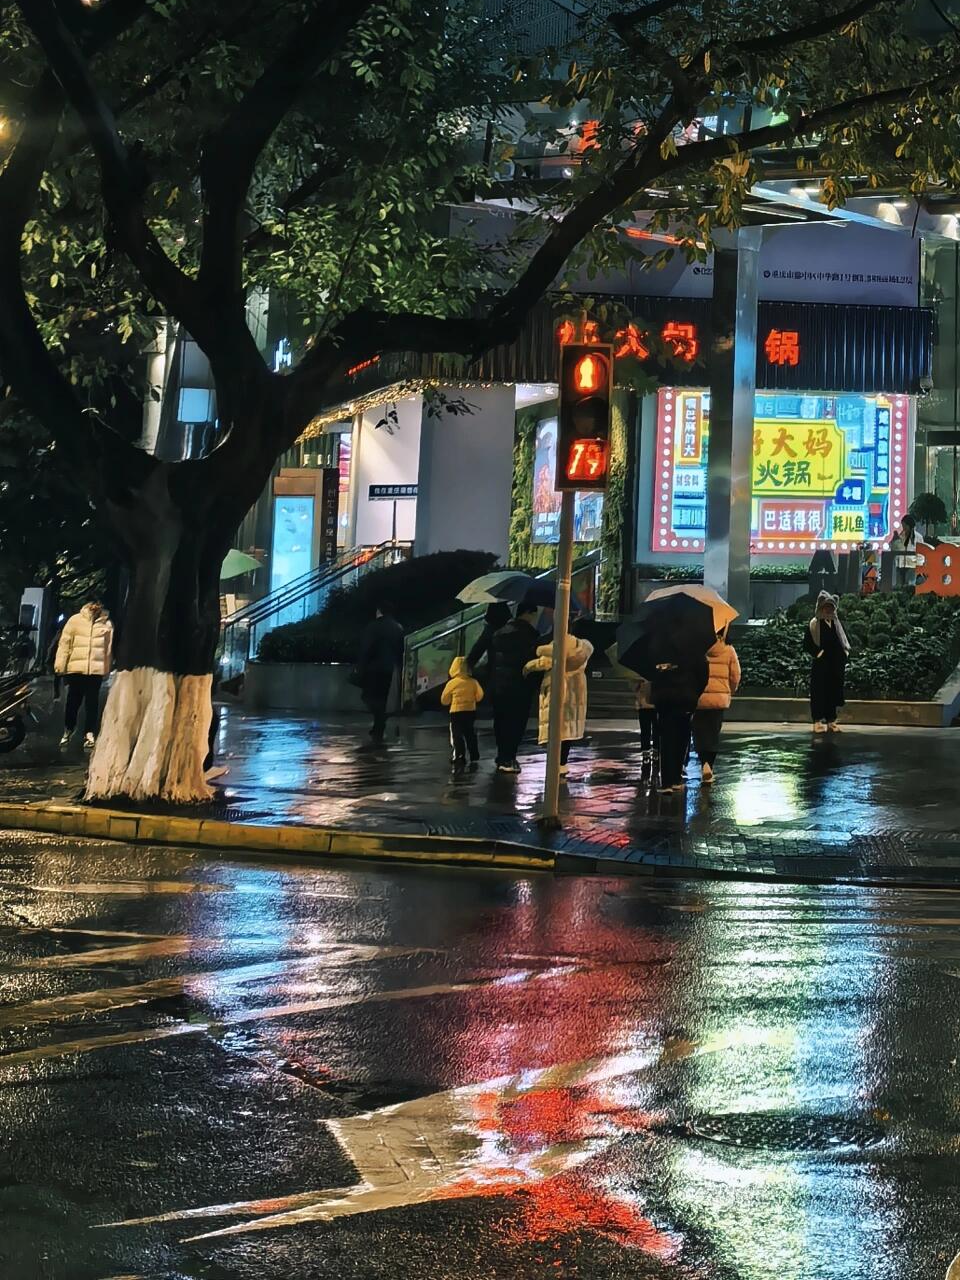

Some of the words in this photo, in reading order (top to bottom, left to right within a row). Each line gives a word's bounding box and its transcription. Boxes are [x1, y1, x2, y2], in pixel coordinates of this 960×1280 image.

[753, 459, 811, 487] 火锅
[763, 509, 822, 532] 巴适得很
